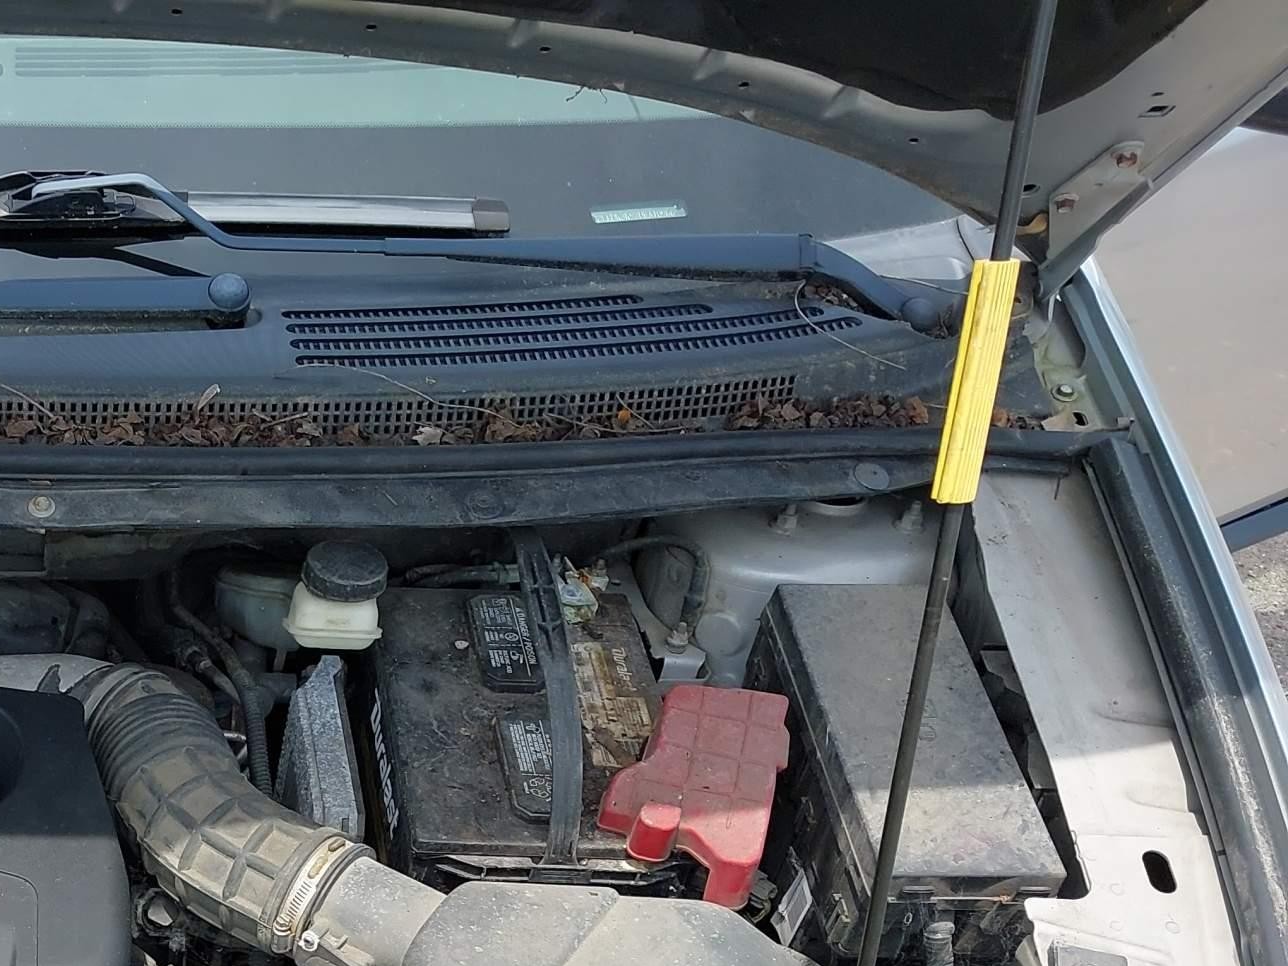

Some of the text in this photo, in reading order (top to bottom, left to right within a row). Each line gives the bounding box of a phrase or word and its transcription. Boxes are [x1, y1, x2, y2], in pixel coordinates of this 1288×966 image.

[516, 613, 530, 637] DANGER
[524, 641, 538, 665] POISON
[370, 687, 399, 841] Duralast
